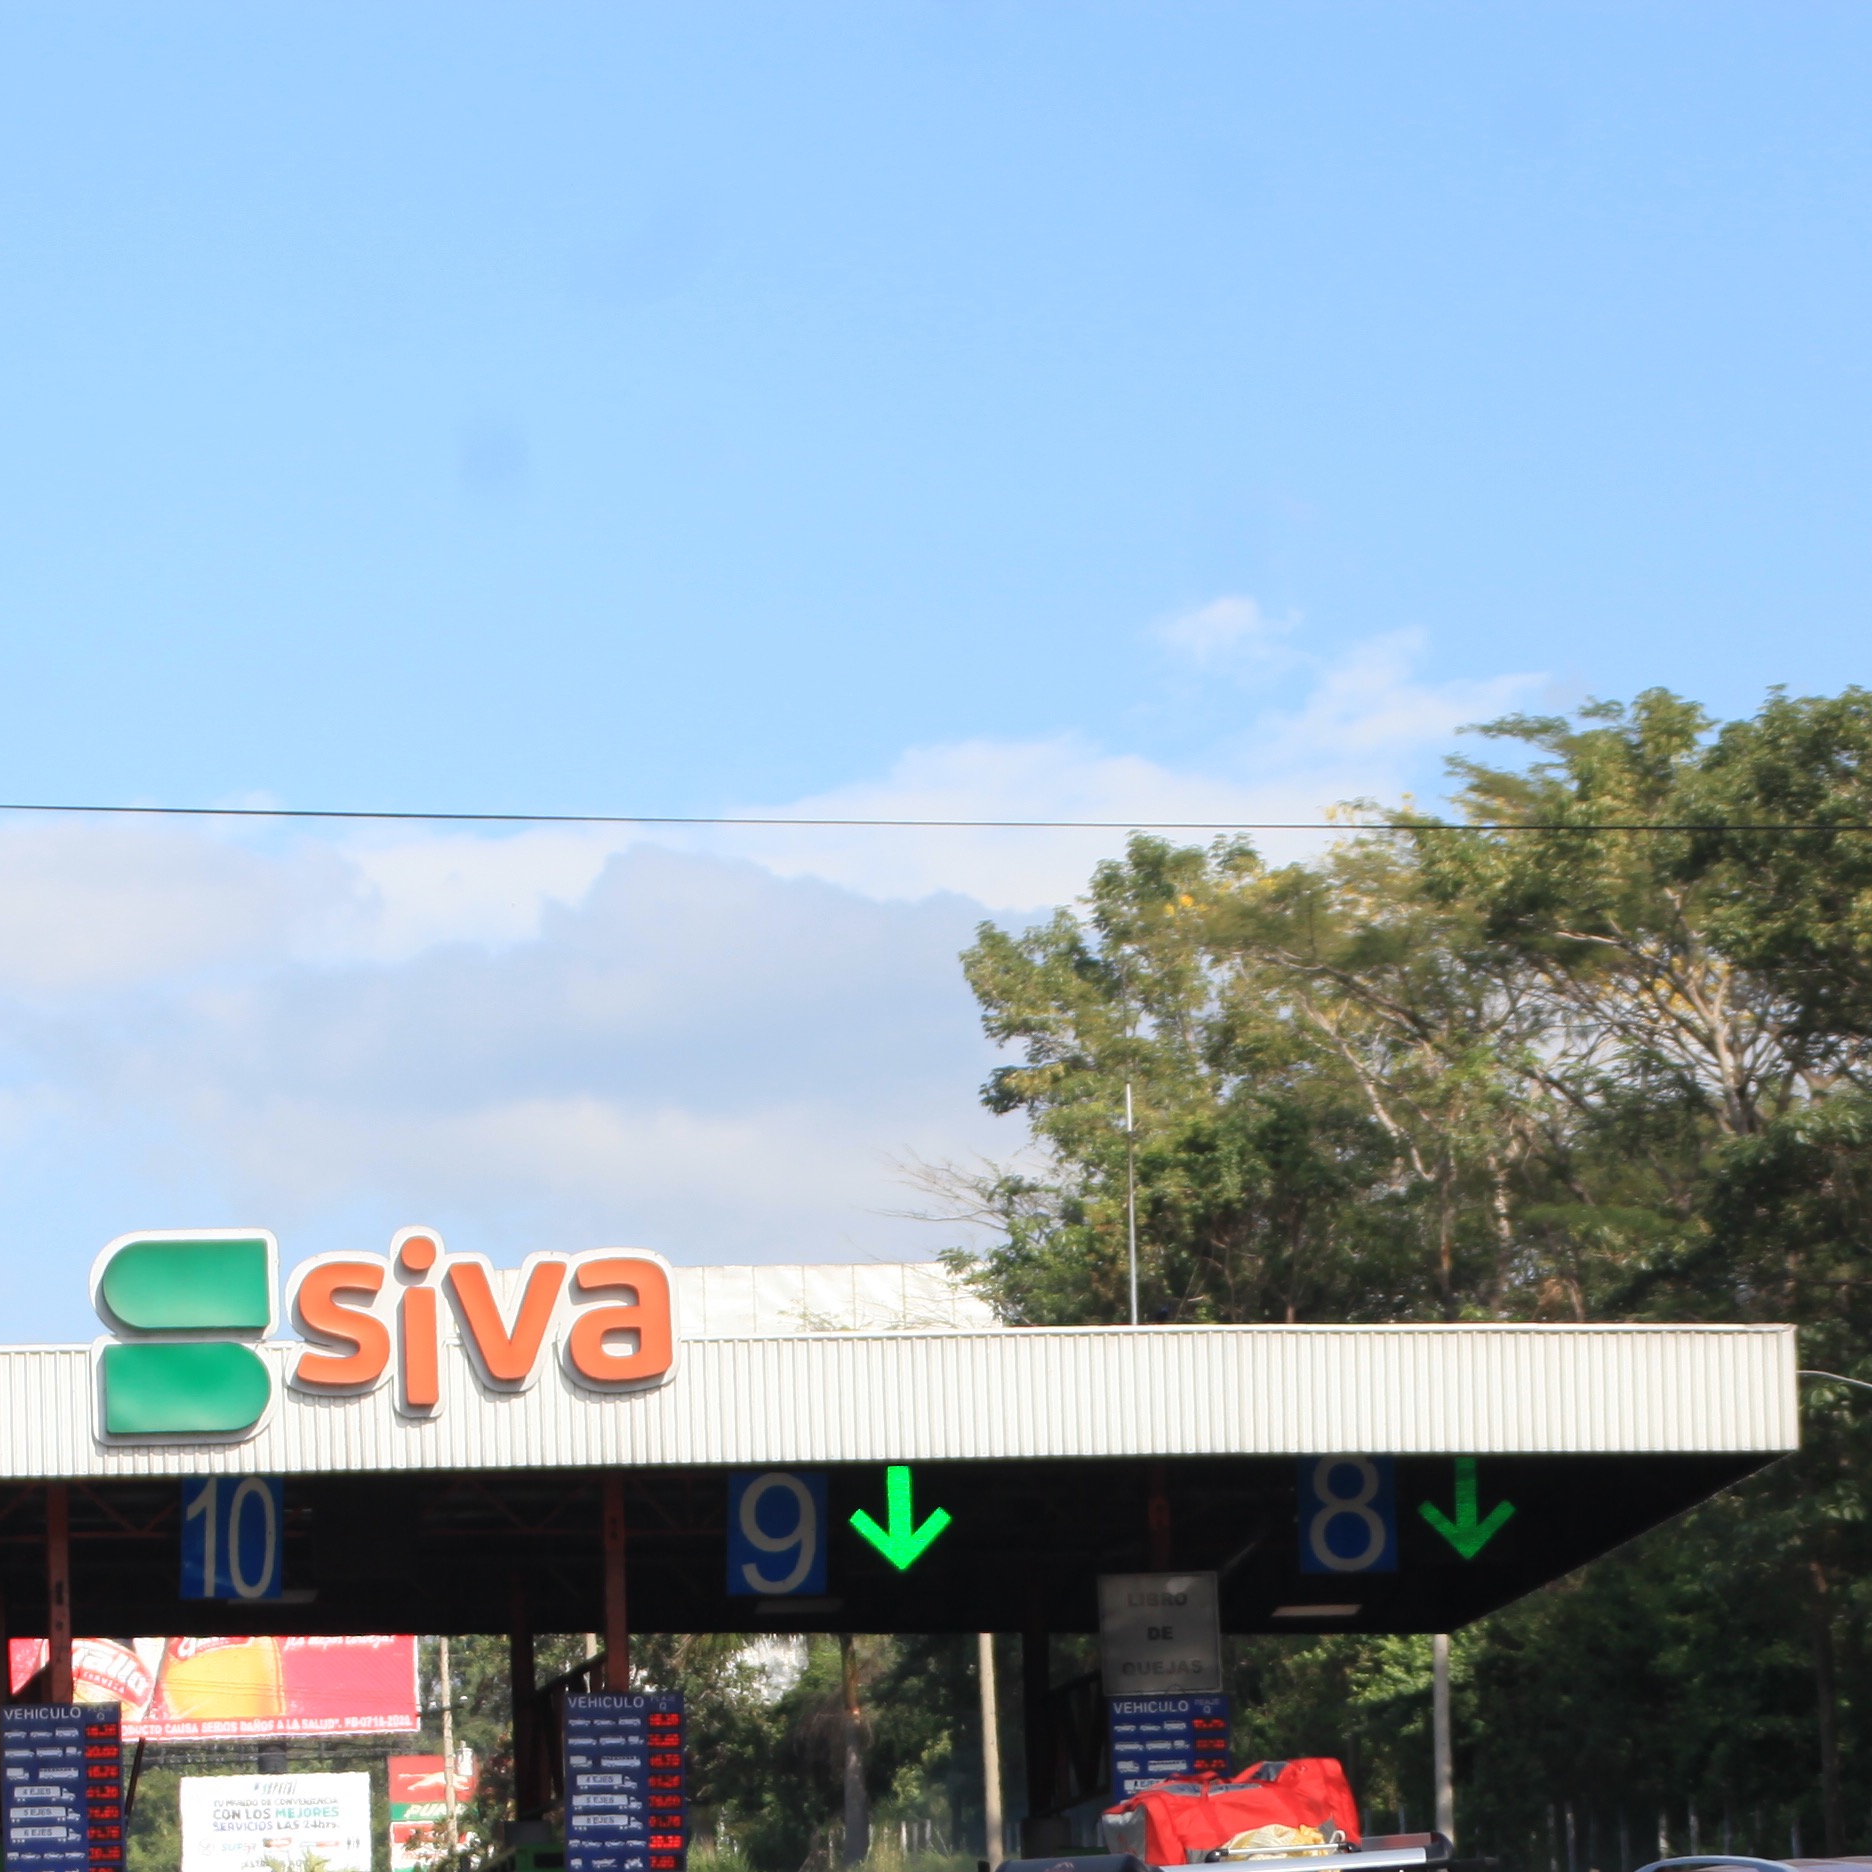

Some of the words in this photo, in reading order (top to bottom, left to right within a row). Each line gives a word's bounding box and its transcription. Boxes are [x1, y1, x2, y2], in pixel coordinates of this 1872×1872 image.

[296, 1235, 673, 1405] siva
[1310, 1453, 1386, 1572] 8
[187, 1475, 276, 1599] 10
[739, 1472, 817, 1594] 9
[1128, 1591, 1188, 1607] LIBRO
[1146, 1625, 1174, 1641] DE
[1122, 1659, 1204, 1676] QUEJAS
[567, 1696, 645, 1709] VEHICULO
[659, 1702, 667, 1711] Q
[1113, 1700, 1190, 1715] VEHICULO
[1202, 1705, 1212, 1714] Q
[3, 1707, 82, 1720] VEHICULO
[96, 1712, 106, 1721] Q
[121, 1724, 163, 1737] ODUCTO
[165, 1722, 199, 1734] CAUSA
[286, 1718, 300, 1730] LA
[213, 1808, 241, 1820] CON
[245, 1808, 271, 1819] LOS
[275, 1806, 340, 1819] MEJORES
[212, 1821, 273, 1832] SERVICIOS
[277, 1821, 300, 1830] LAS
